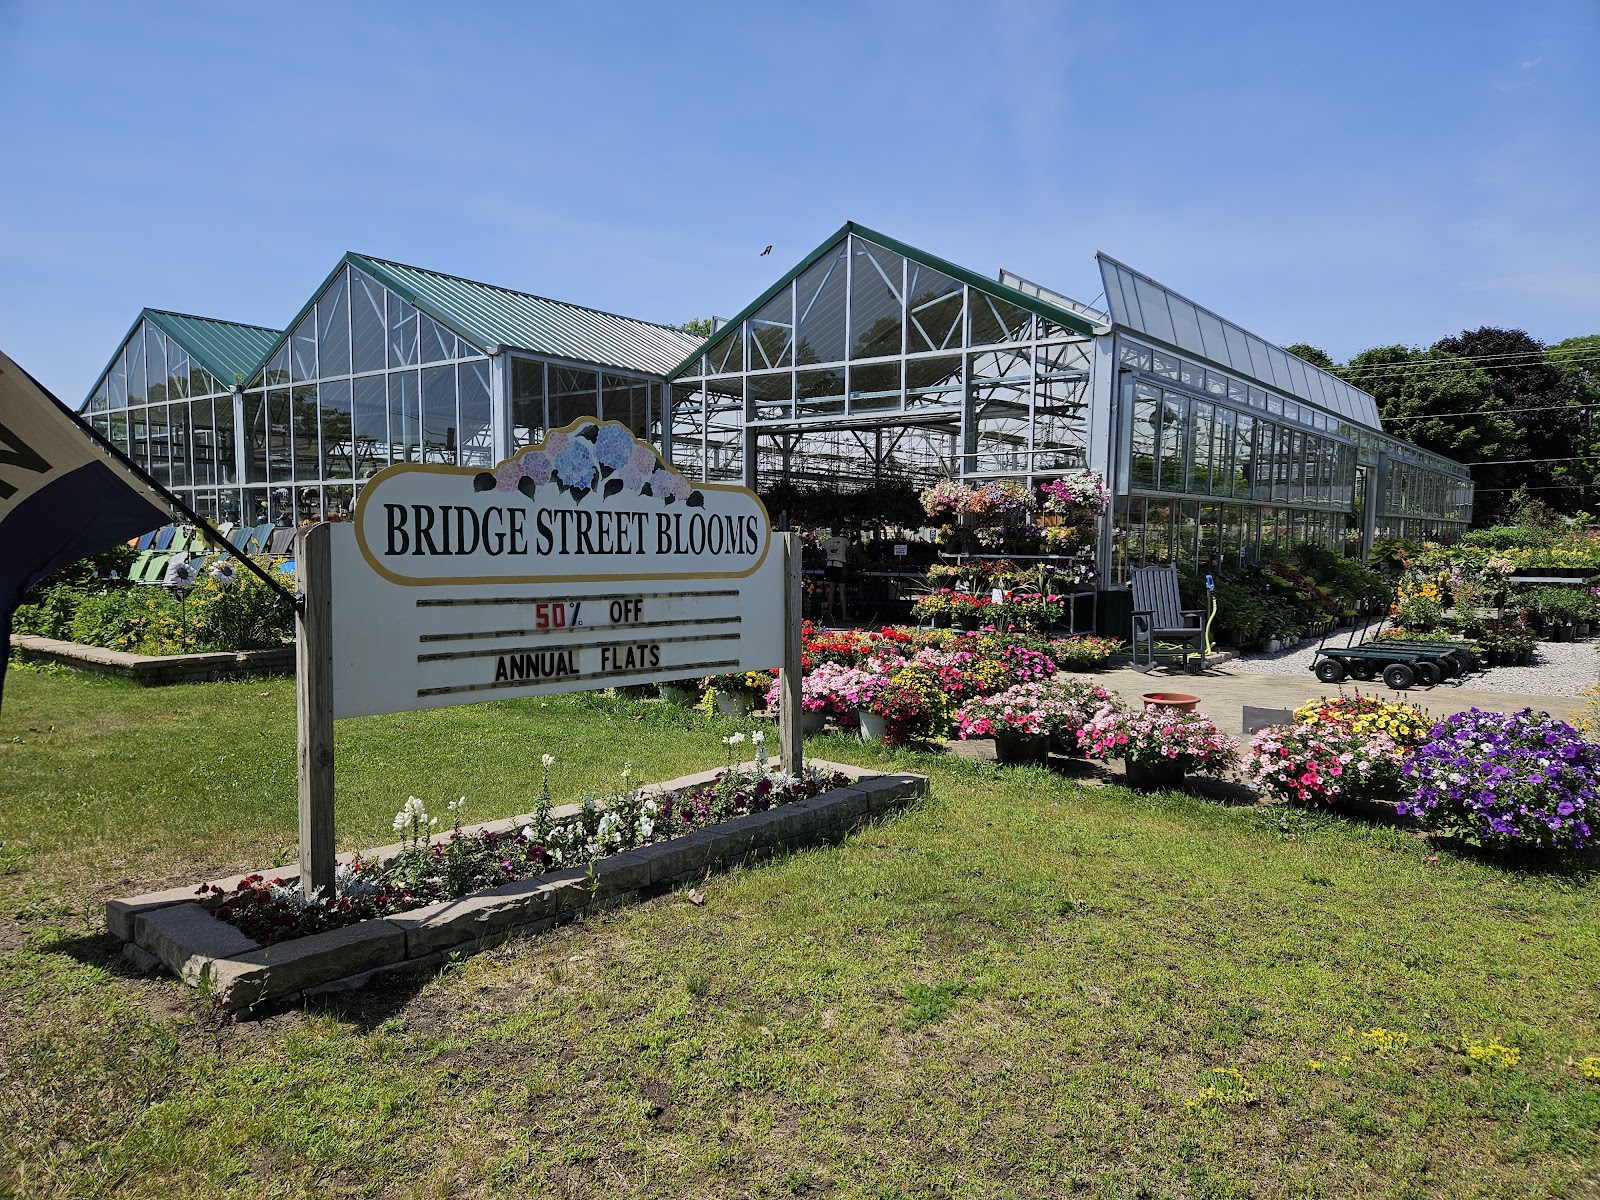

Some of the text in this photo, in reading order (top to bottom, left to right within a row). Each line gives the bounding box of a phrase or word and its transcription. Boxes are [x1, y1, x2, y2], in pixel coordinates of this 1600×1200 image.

[383, 503, 758, 556] BRIDGE STREET BLOOMS
[536, 599, 644, 629] 50% OFF
[495, 644, 660, 681] ANNUAL FLATS
